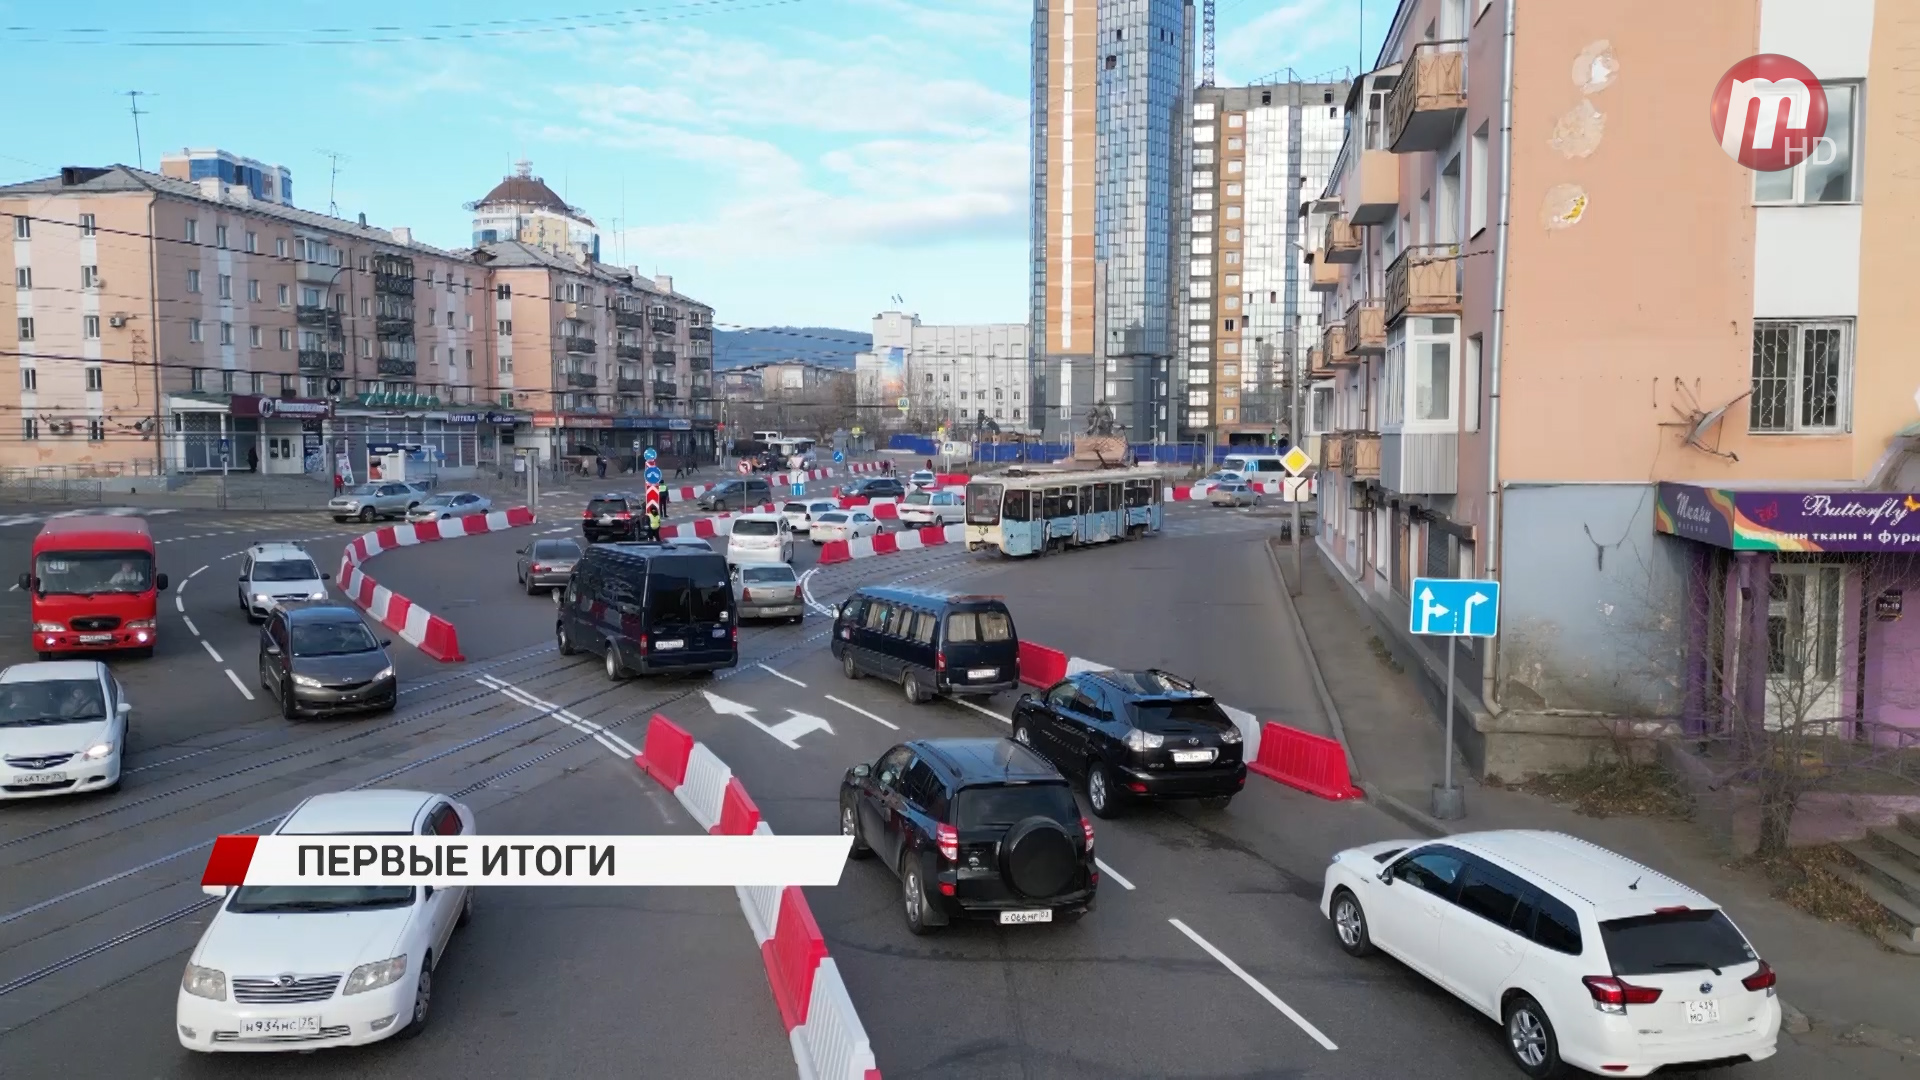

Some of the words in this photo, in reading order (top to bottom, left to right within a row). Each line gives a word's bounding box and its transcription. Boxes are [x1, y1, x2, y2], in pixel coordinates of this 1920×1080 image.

[1801, 495, 1909, 526] Butterfly
[1812, 532, 1857, 541] ткани
[1863, 532, 1872, 541] и
